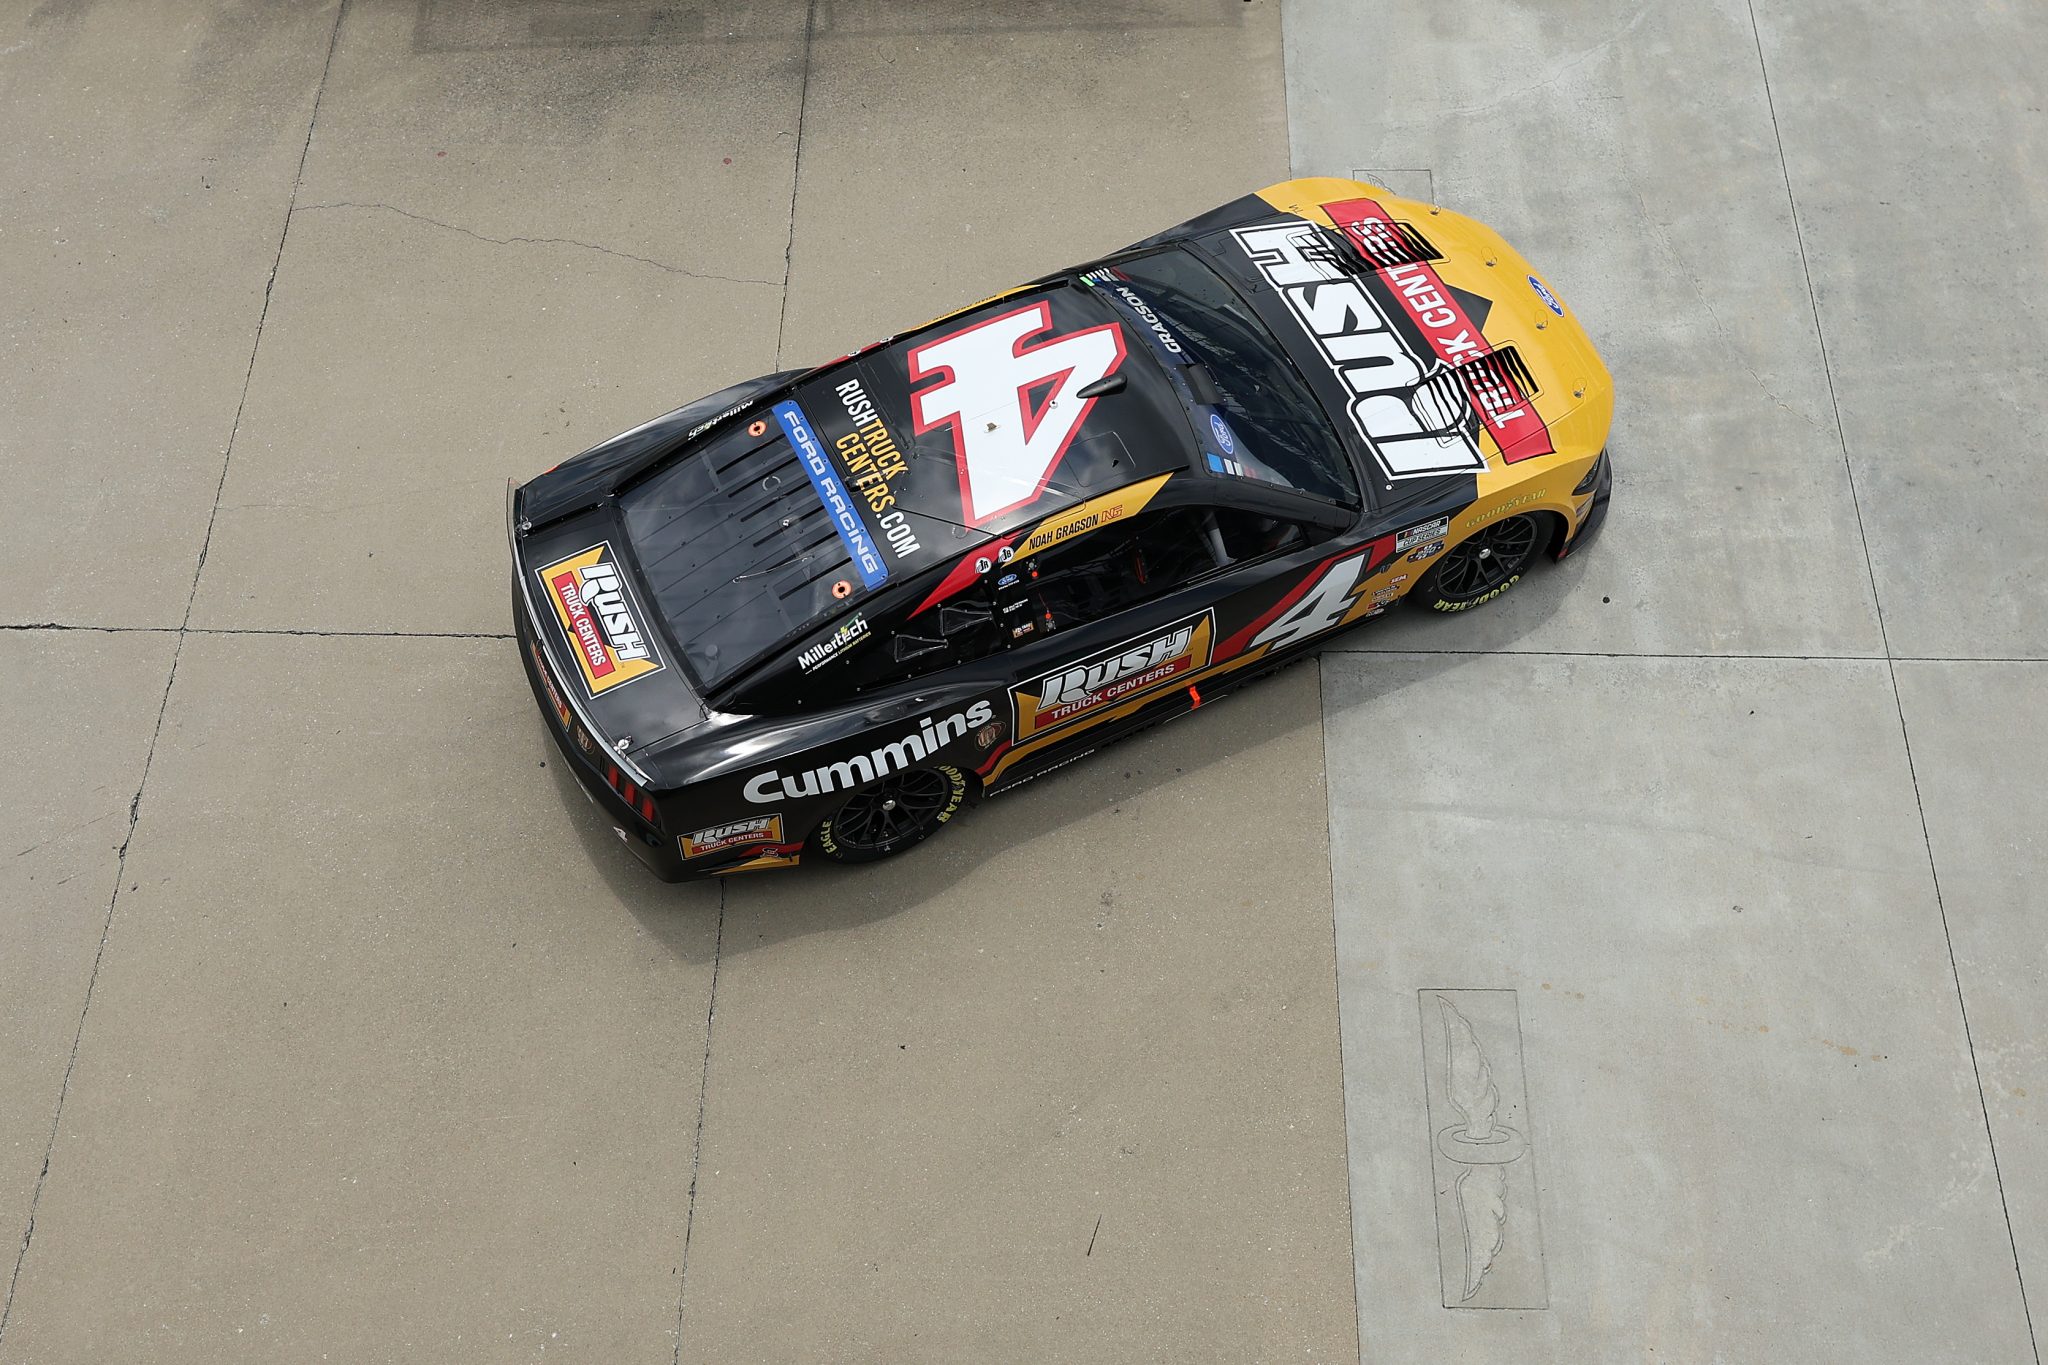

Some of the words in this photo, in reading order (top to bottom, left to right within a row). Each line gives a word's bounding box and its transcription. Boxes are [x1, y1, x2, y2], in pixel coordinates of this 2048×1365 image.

[1116, 285, 1182, 354] GRAGSON
[1229, 220, 1491, 480] RUSH
[908, 300, 1128, 533] 4
[784, 410, 826, 476] FORD
[821, 477, 879, 574] RACING
[836, 432, 920, 559] CENTERS.COM
[1028, 530, 1054, 550] NOAH
[1055, 513, 1099, 540] GRAGSON
[560, 582, 586, 619] TRUCK
[575, 617, 607, 667] CENTERS
[577, 561, 651, 662] RUSH
[797, 617, 869, 670] Millertech
[1247, 552, 1368, 652] 4
[1036, 625, 1194, 712] RUSH
[1051, 691, 1103, 719] TRUCK
[1106, 663, 1175, 697] CENTERS
[742, 699, 994, 804] Cummins
[934, 765, 967, 823] OODYEAR
[692, 817, 771, 845] RUSH
[700, 840, 728, 851] TRUCK
[728, 832, 765, 843] CENTERS
[820, 819, 838, 854] EAGLE
